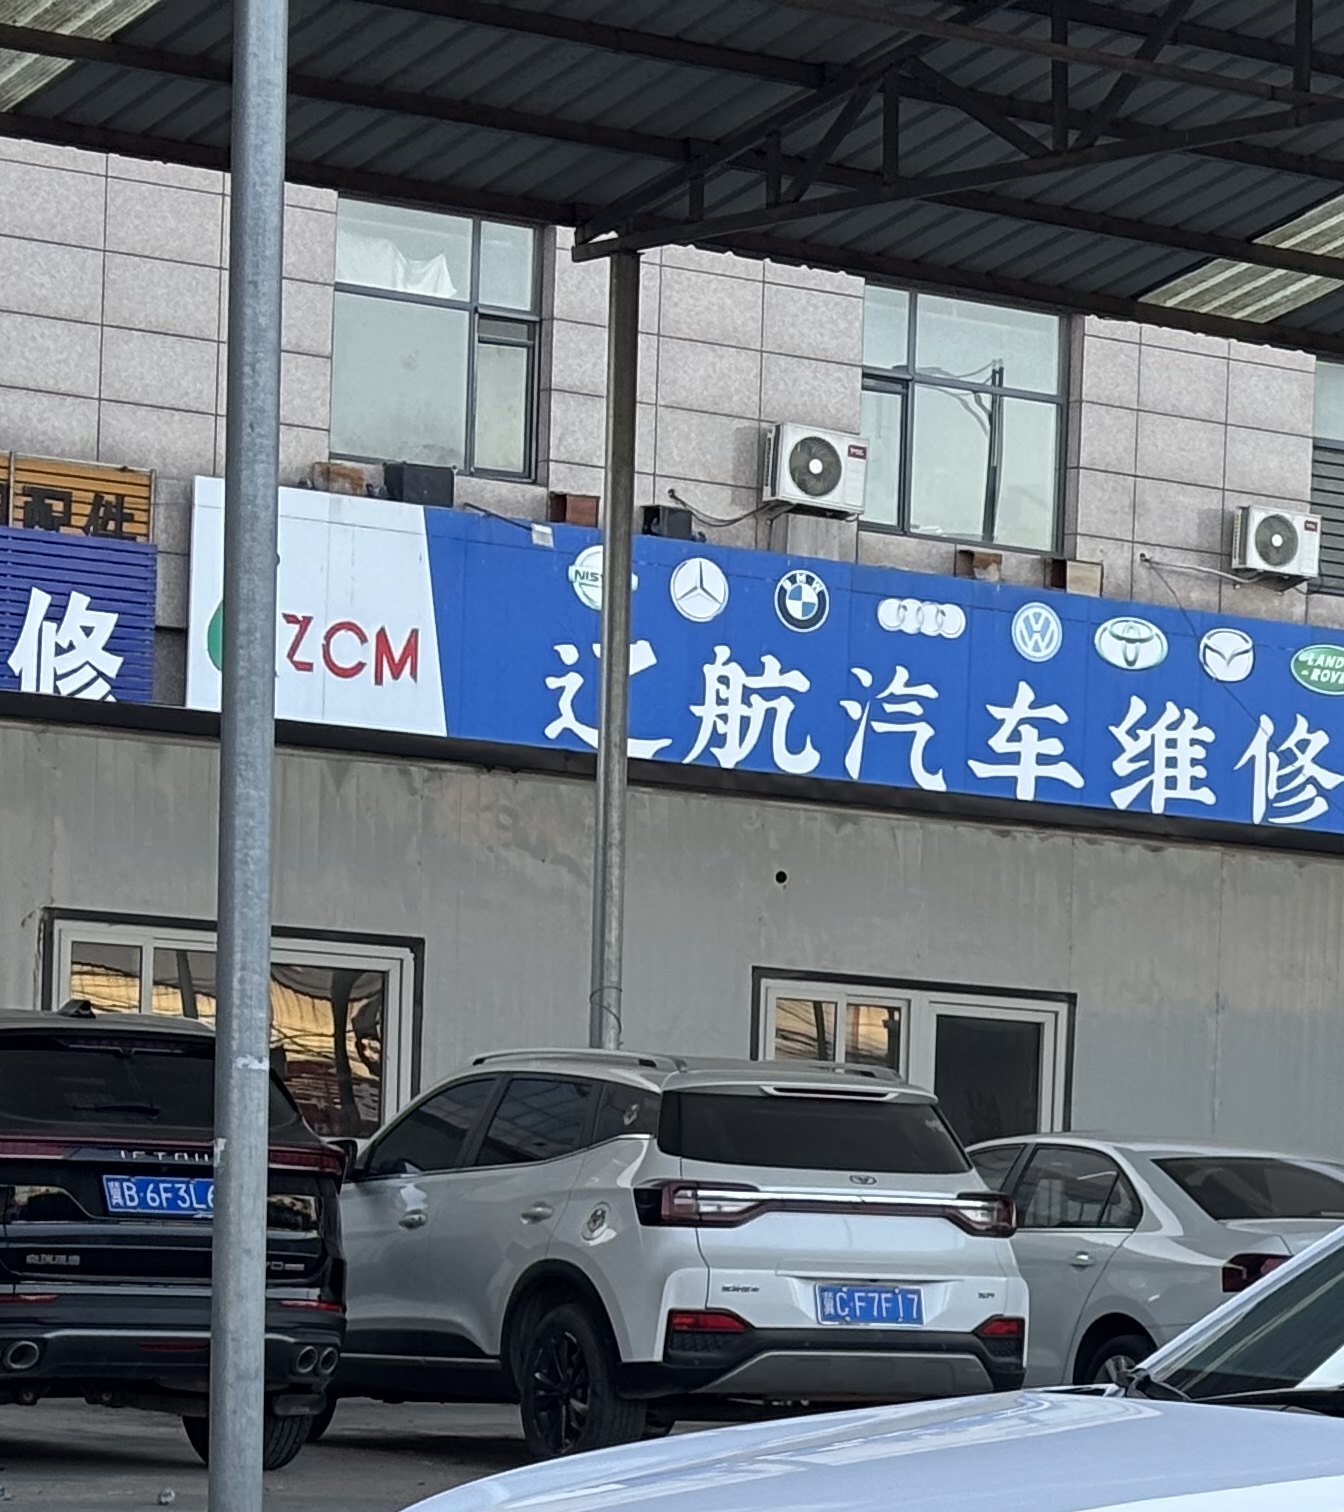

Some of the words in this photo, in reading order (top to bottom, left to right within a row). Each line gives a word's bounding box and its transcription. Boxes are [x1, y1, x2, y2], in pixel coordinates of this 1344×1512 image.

[0, 483, 139, 541] 配件
[7, 586, 124, 702] 修
[281, 612, 420, 686] ZCM
